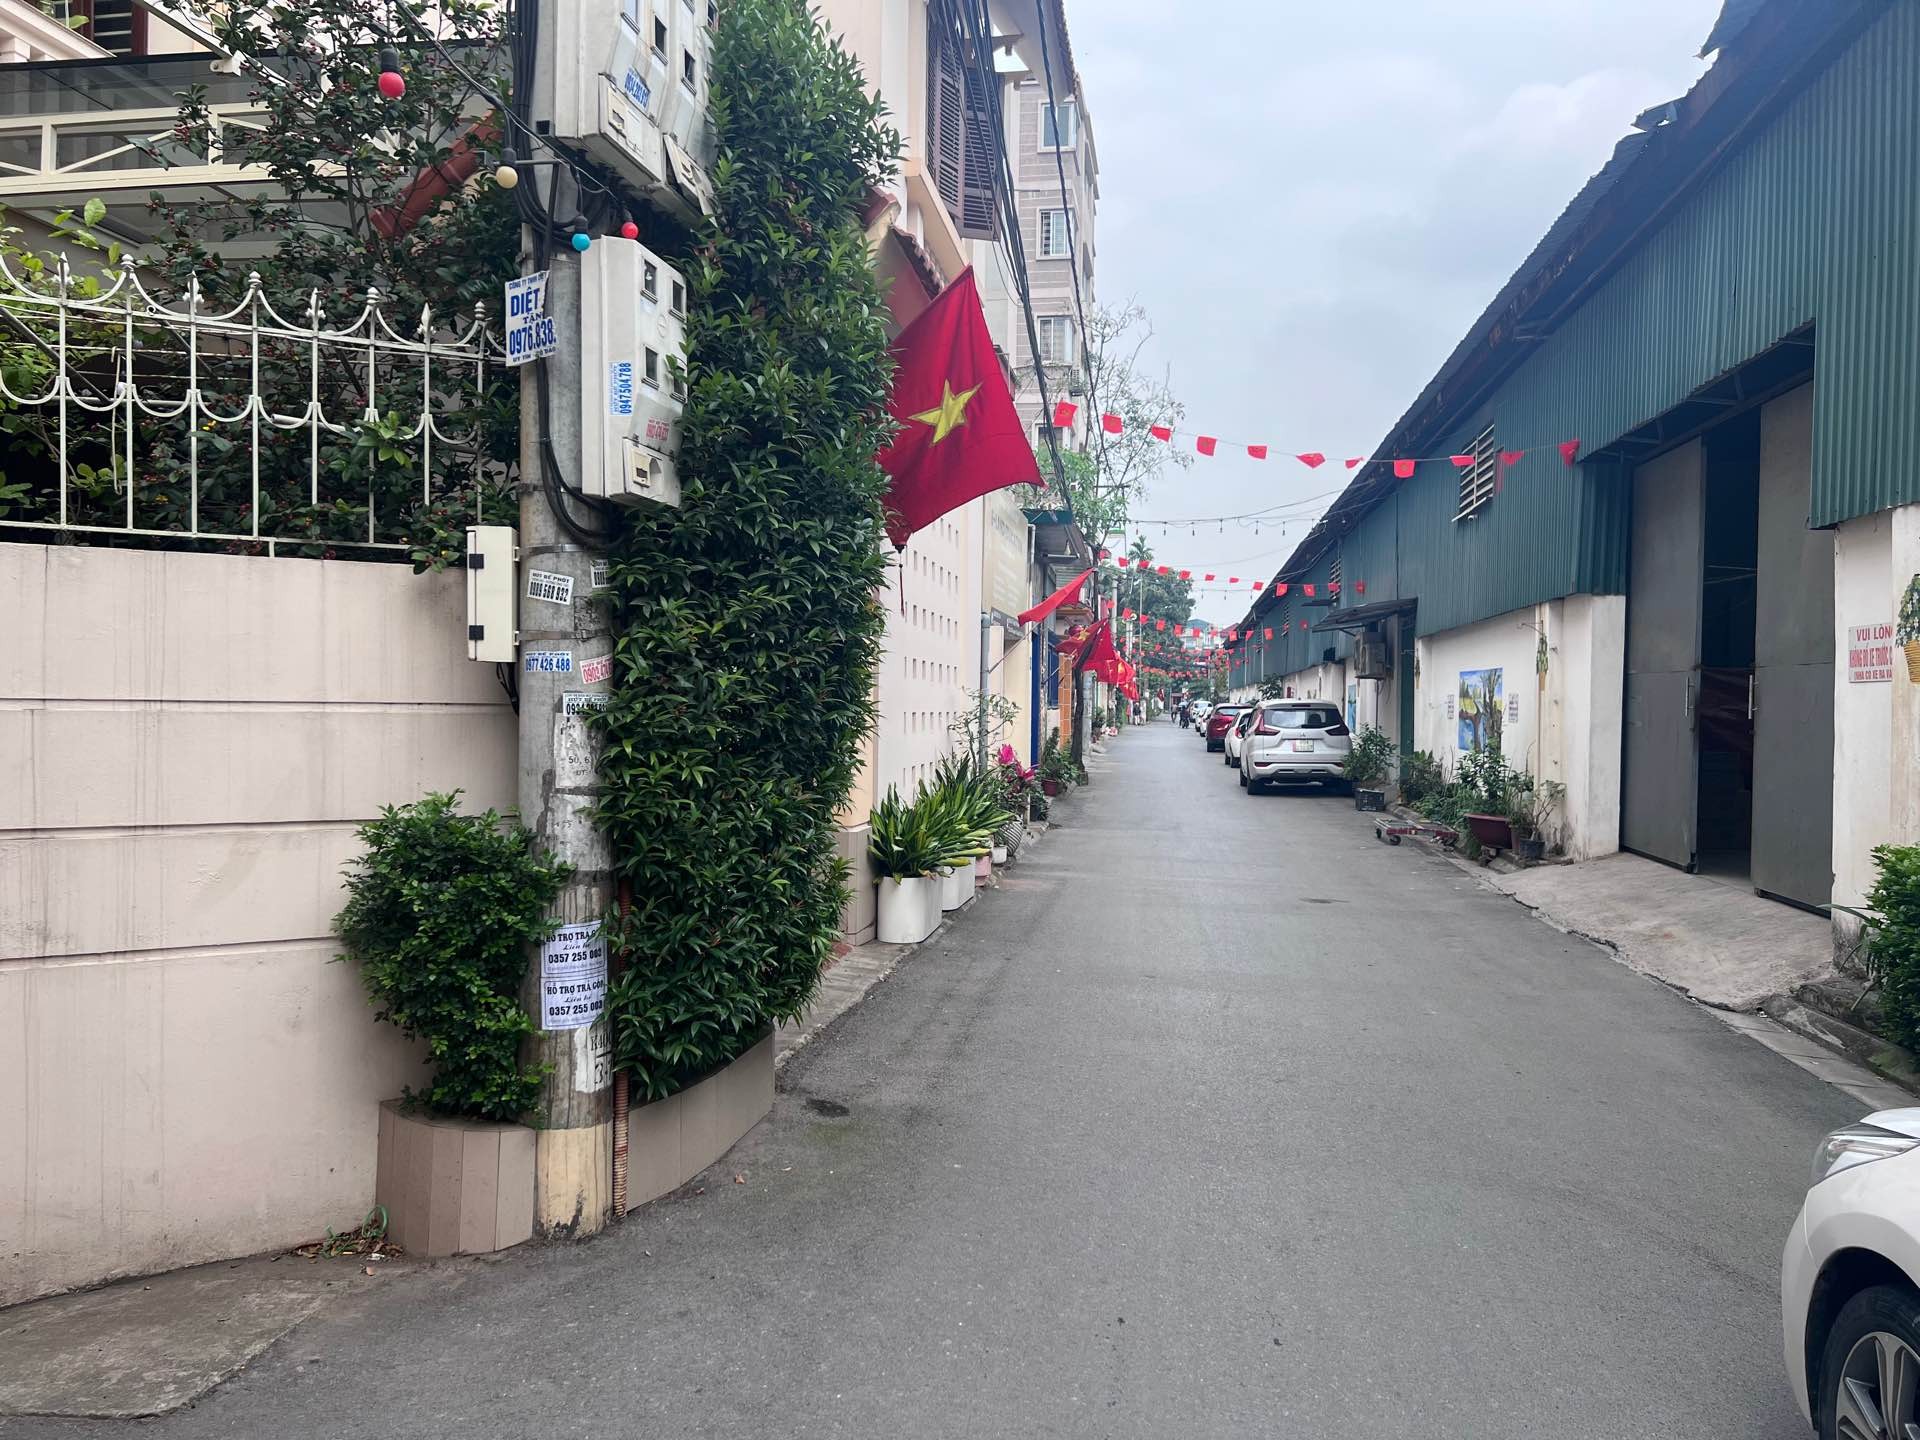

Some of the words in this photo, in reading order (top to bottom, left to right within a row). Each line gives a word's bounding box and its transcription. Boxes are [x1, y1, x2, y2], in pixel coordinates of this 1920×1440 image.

[510, 287, 541, 318] DIỆT
[1856, 627, 1870, 641] VUI
[548, 953, 570, 964] 0357
[572, 950, 588, 962] 255
[559, 983, 575, 996] TRỢ
[549, 1006, 571, 1016] 0357
[572, 1003, 589, 1015] 255
